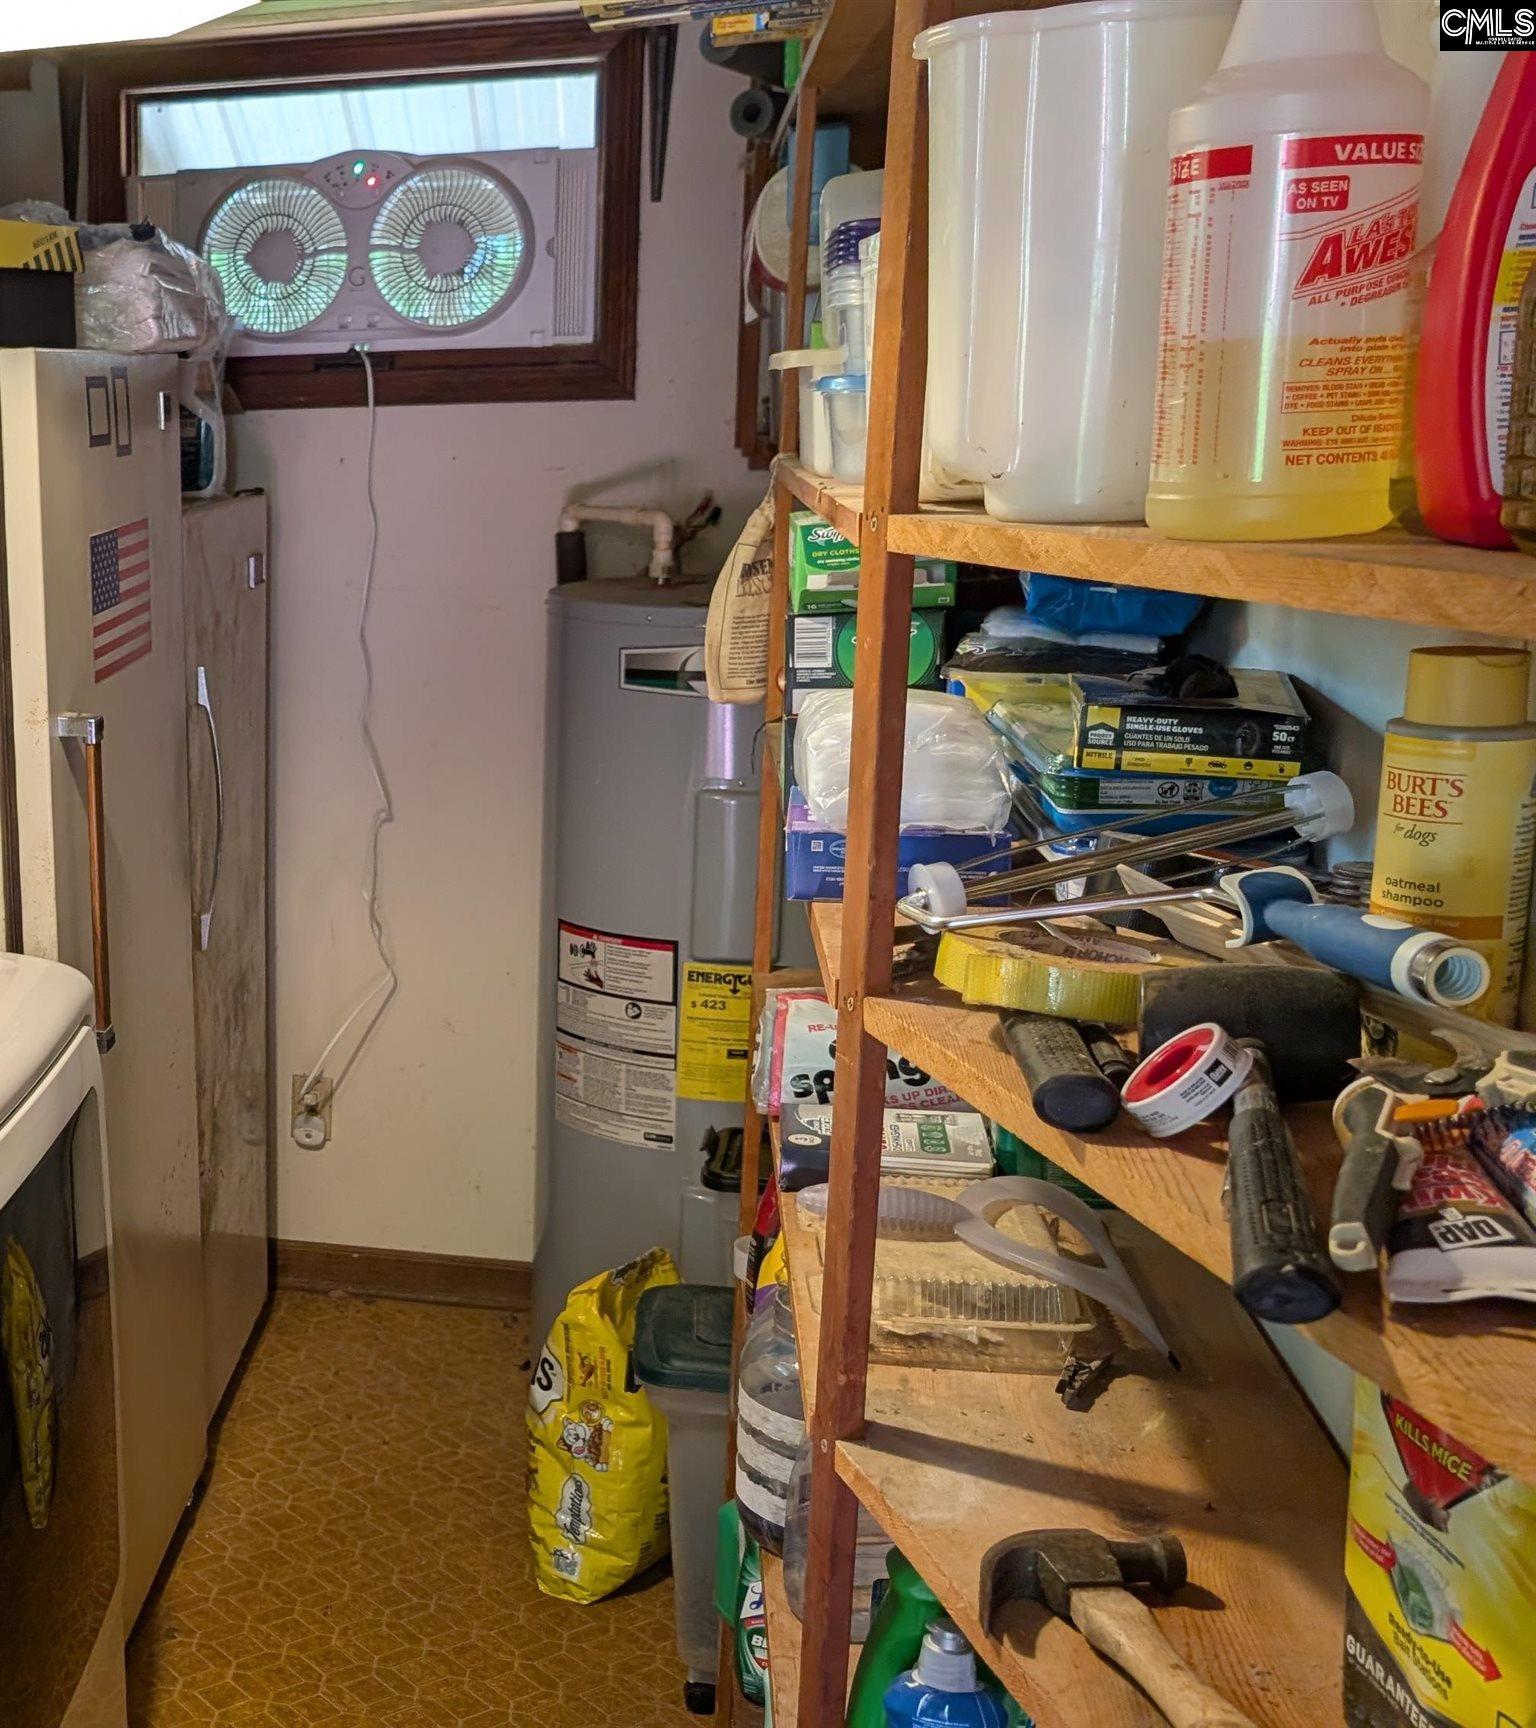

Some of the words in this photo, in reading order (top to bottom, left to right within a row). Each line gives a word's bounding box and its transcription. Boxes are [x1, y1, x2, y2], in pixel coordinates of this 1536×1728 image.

[1334, 143, 1406, 161] VALUE
[1287, 181, 1306, 195] AS
[1311, 179, 1348, 193] SEEN
[1296, 198, 1317, 210] ON
[1323, 196, 1339, 208] TV
[1308, 294, 1331, 307] ALL
[1335, 278, 1383, 300] PURPOSE
[1308, 335, 1362, 346] Actually
[1299, 356, 1351, 368] CLEANS
[1326, 367, 1367, 377] SPRAY
[1303, 427, 1333, 436] KEEP
[1336, 425, 1357, 435] OUT
[1360, 424, 1372, 433] OF
[1286, 455, 1312, 465] NET
[1317, 451, 1377, 465] CONTENTS
[812, 550, 827, 558] DRY
[830, 548, 860, 556] CLOTHS
[1126, 716, 1179, 725] HEAVY-DUTY
[1126, 723, 1172, 732] SINGLE-USE
[1172, 726, 1204, 734] GLOVES
[1125, 732, 1153, 740] GUANTES
[1272, 732, 1287, 742] 50
[1156, 742, 1183, 750] TRABAJO
[1183, 744, 1209, 752] PESADO
[1085, 751, 1113, 760] NITRILE
[1387, 771, 1464, 798] BURT'S
[1393, 794, 1448, 819] BEES
[1404, 824, 1437, 847] dogs
[1385, 876, 1440, 893] oatmeal
[1382, 889, 1444, 908] shampoo
[701, 1000, 726, 1011] 423
[903, 1091, 920, 1101] UP
[925, 1085, 950, 1097] DIR
[1438, 1219, 1502, 1244] DAP
[1395, 1412, 1429, 1452] KILLS
[1431, 1442, 1472, 1481] MICE
[1389, 1611, 1452, 1689] Ready-to-Use
[1346, 1634, 1436, 1728] GUARANTEE
